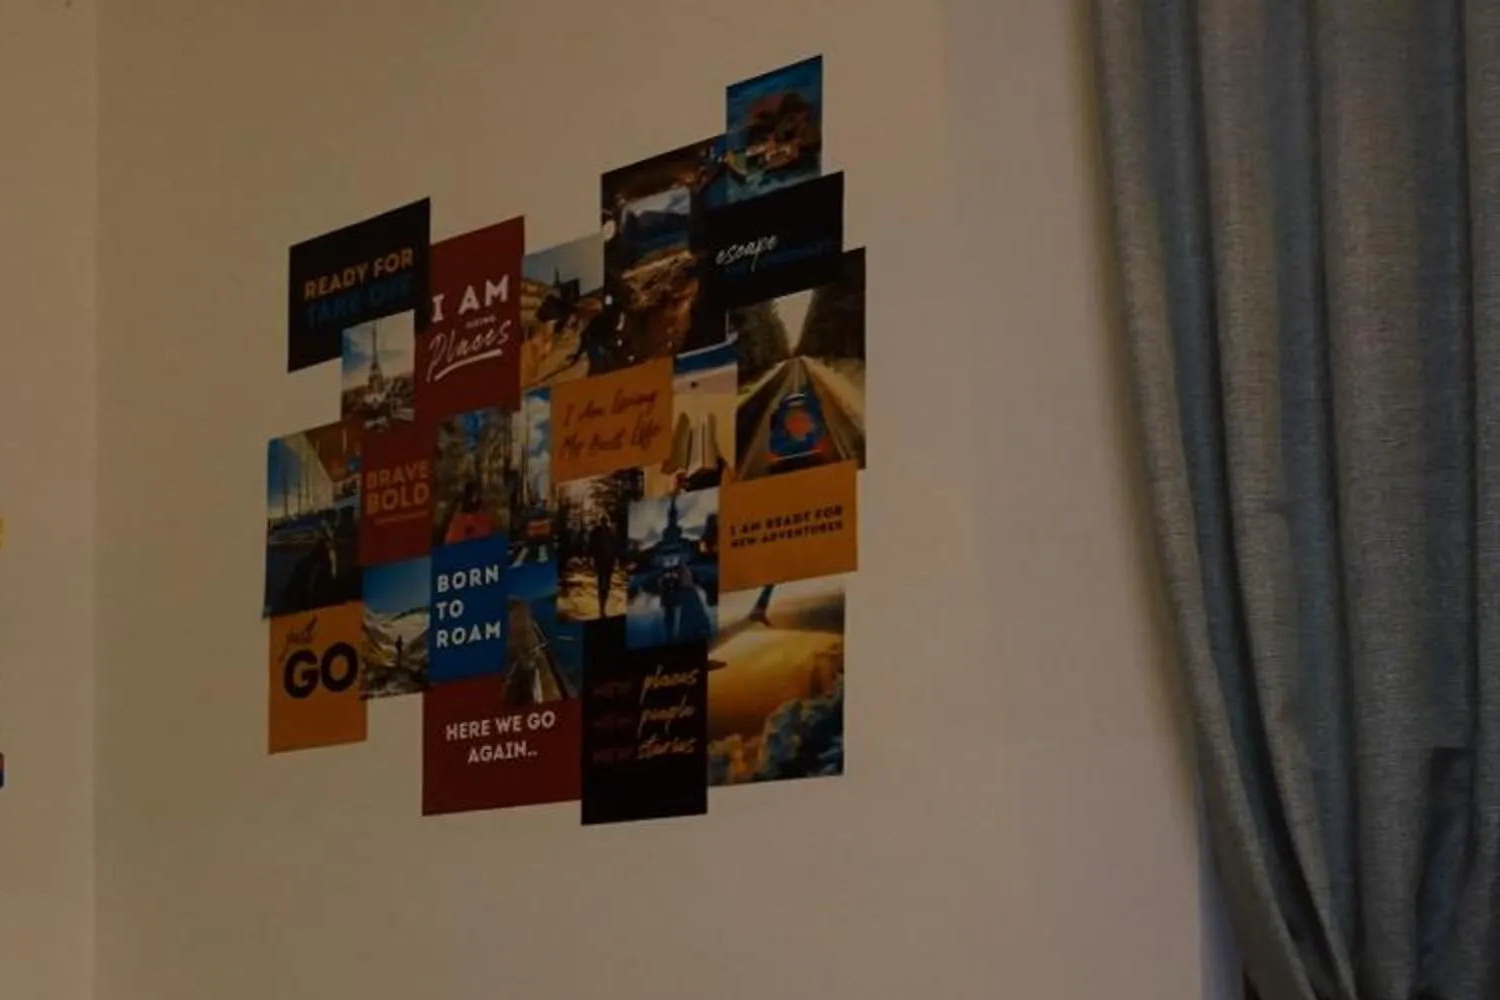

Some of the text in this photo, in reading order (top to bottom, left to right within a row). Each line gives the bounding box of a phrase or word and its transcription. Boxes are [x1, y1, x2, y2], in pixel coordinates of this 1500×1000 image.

[303, 247, 414, 301] READY FOR
[431, 273, 510, 323] I AM
[365, 459, 430, 490] BRAVE
[366, 482, 430, 515] BOLD
[741, 522, 761, 534] AM
[766, 511, 811, 529] READY
[814, 505, 843, 519] FOR
[437, 564, 499, 593] BORN
[436, 599, 464, 620] TO
[436, 620, 501, 649] ROAM
[284, 641, 358, 698] GO
[446, 710, 556, 742] HERE WE GO
